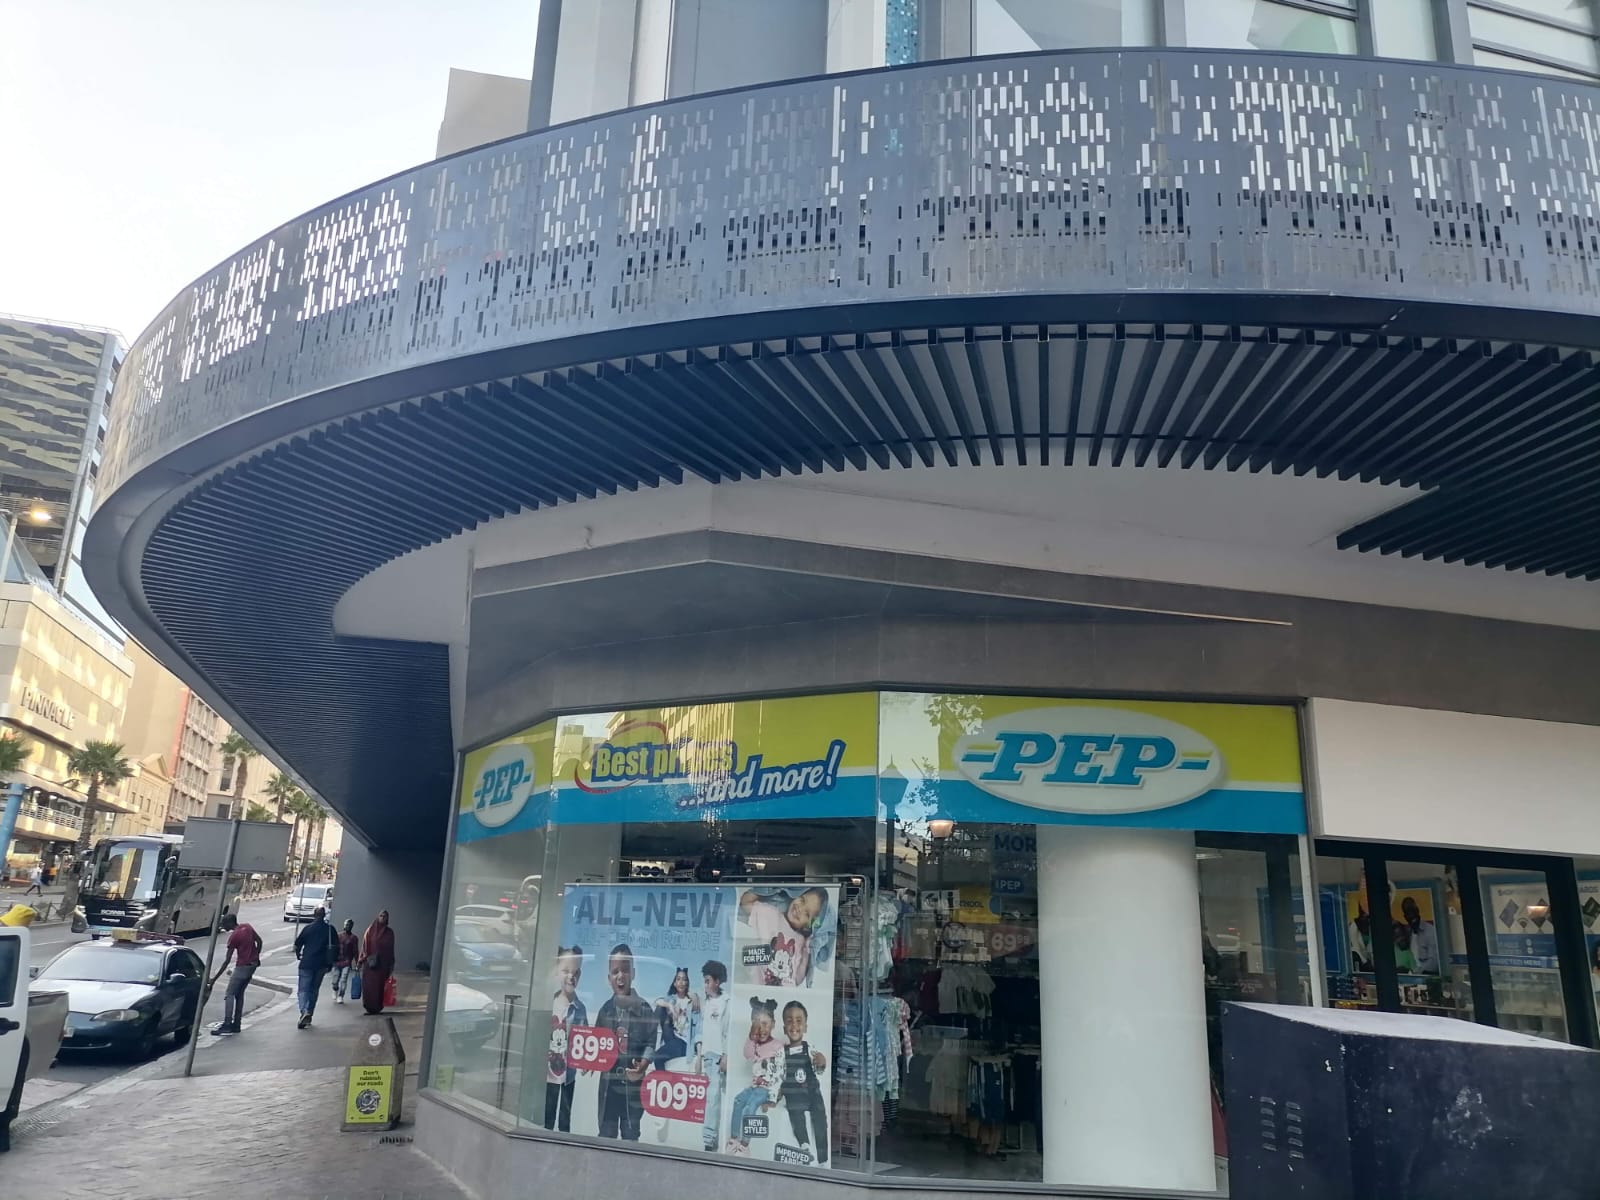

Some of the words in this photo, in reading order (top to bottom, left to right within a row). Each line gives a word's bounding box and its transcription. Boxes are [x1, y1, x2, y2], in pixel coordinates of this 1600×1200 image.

[21, 686, 75, 731] PINNACLE
[595, 747, 649, 778] Best
[652, 743, 733, 778] pres
[758, 744, 841, 796] more!
[976, 732, 1177, 786] PEP
[475, 759, 525, 810] PEP
[575, 891, 724, 929] ALL-NEW
[748, 947, 765, 956] MADE
[756, 954, 771, 962] PLAY
[743, 1126, 767, 1135] STYLES
[748, 1119, 763, 1127] NEW
[776, 1146, 810, 1163] IMPROVED
